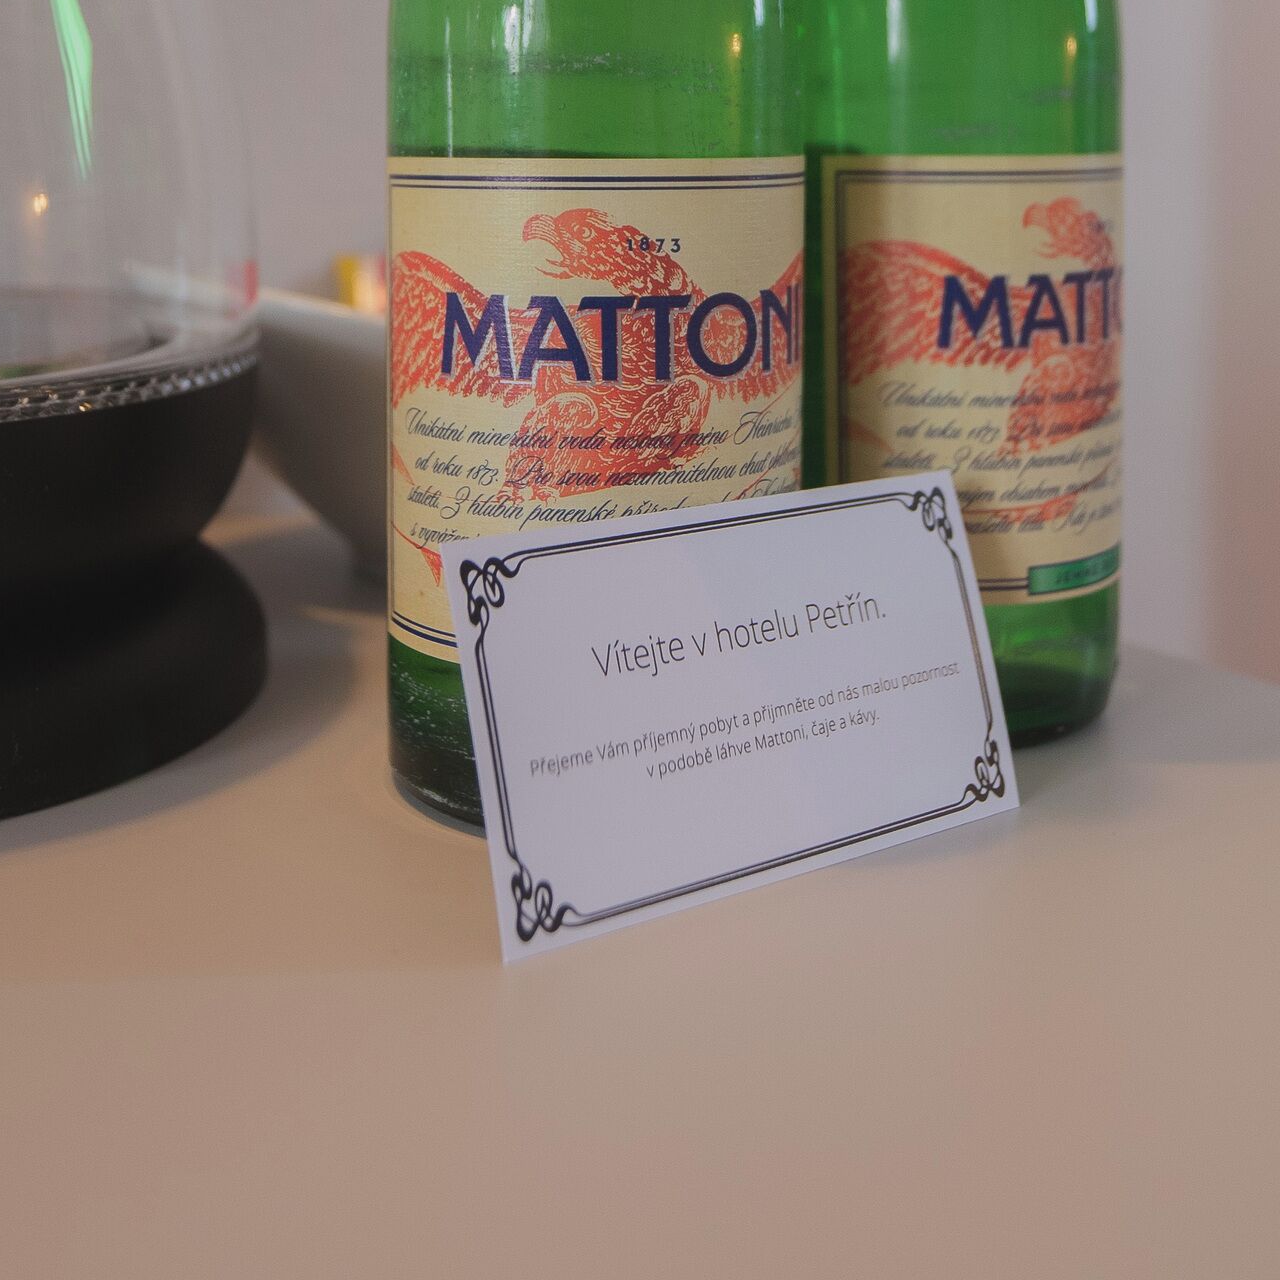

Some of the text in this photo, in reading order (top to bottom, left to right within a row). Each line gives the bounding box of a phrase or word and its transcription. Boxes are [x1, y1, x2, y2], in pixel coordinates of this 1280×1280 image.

[625, 237, 682, 254] 1873
[936, 266, 1121, 349] MATT
[406, 407, 467, 442] Unikátní
[467, 427, 556, 448] minerální
[558, 425, 607, 450] voda
[415, 451, 435, 468] od
[432, 455, 463, 477] roku
[558, 469, 602, 487] svou
[467, 493, 524, 520] hlubin
[591, 592, 887, 677] Vítejte v hotelu Petřín.
[529, 662, 960, 777] Přejeme Vám příjemný pobyt a přijmněte od nás malou pozornost
[646, 709, 880, 779] v podobě láhve Mattoni, čaje a kávy.
